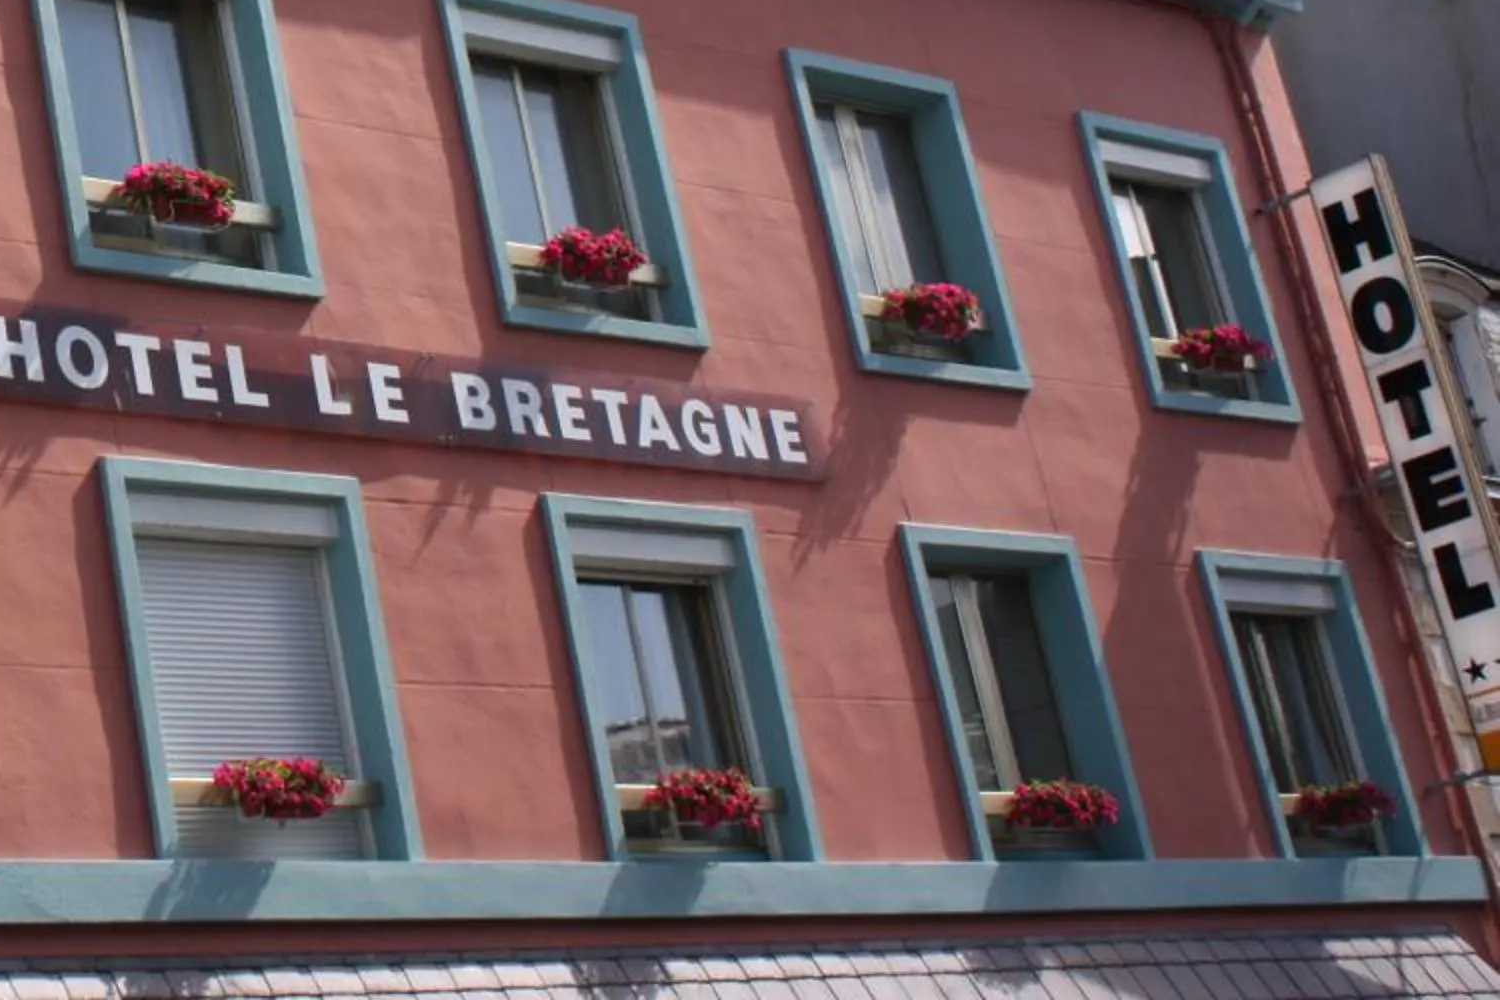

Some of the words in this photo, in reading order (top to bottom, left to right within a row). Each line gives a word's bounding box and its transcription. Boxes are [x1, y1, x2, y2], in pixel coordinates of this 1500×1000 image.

[309, 353, 411, 424] LE
[449, 370, 809, 465] BRETAGNE
[1322, 187, 1495, 620] HOTEL
